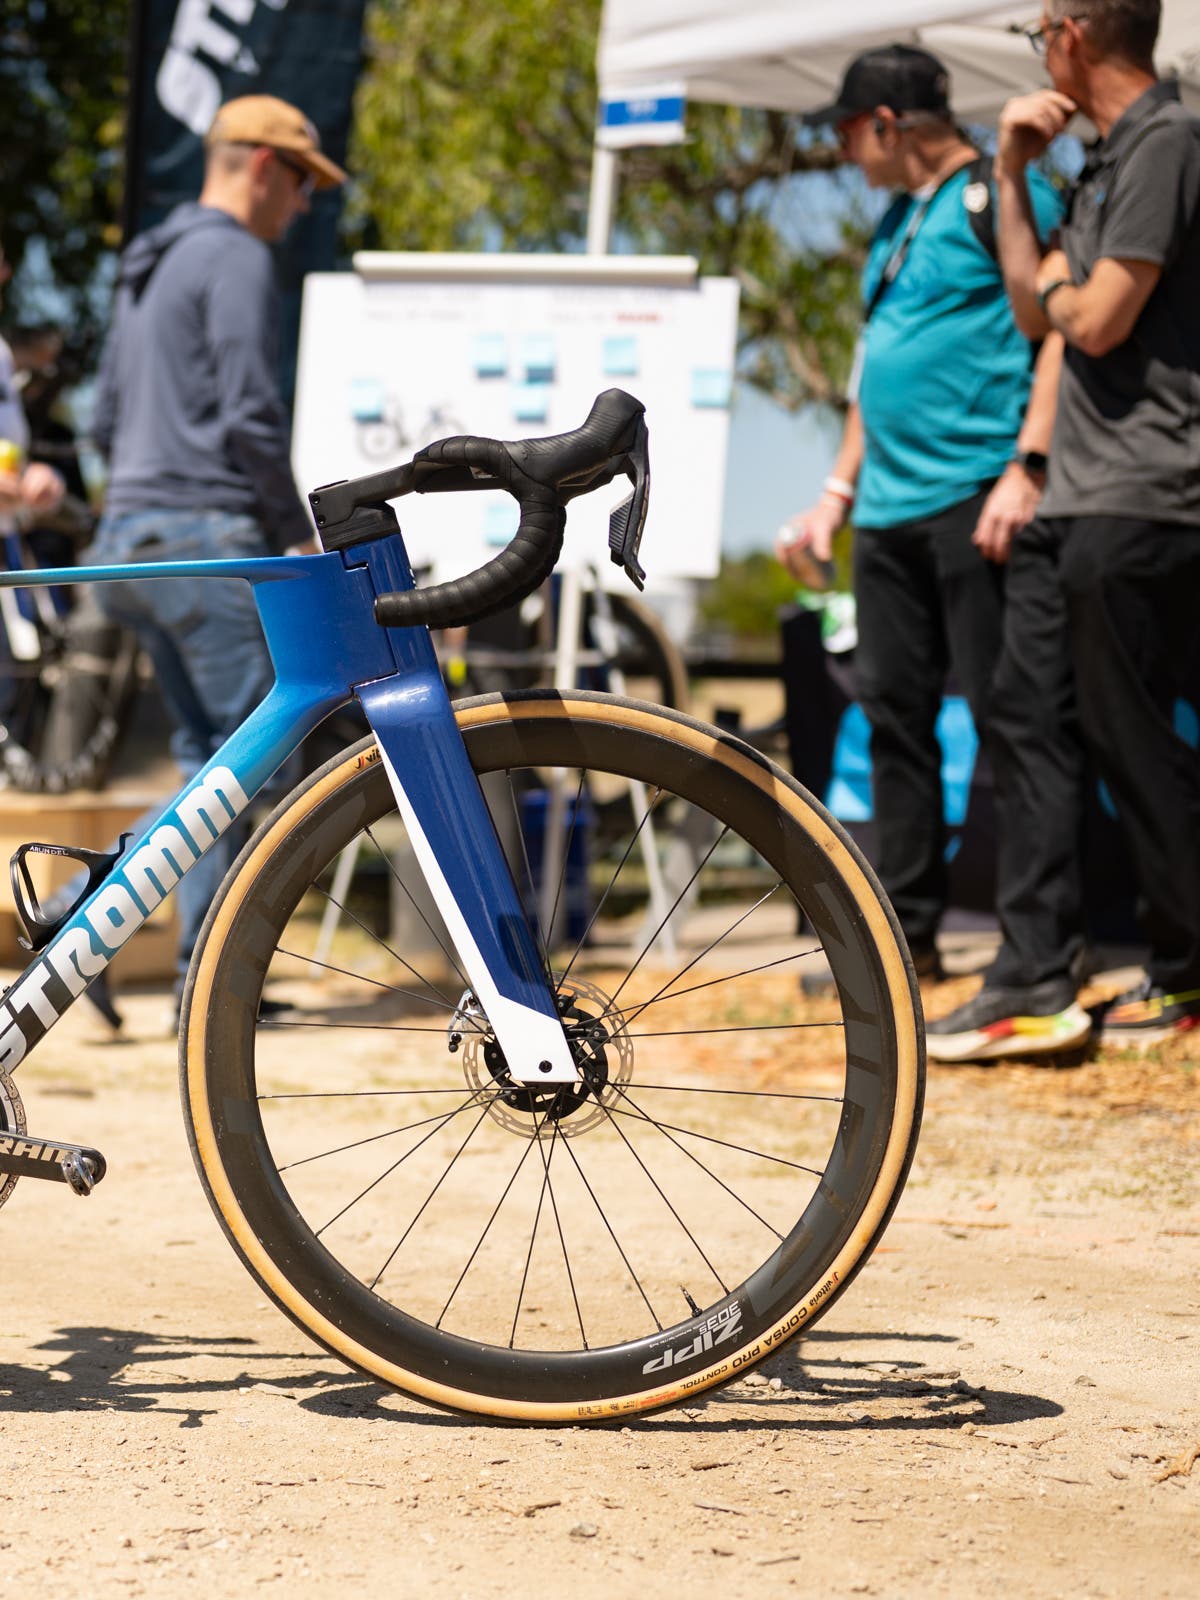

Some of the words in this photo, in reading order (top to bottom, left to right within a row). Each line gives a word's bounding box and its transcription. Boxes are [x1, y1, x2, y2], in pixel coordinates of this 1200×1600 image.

[29, 845, 69, 857] ARUNDEL
[809, 1278, 835, 1307] vittoria
[763, 1307, 808, 1347] CORSA
[642, 1311, 744, 1375] ZIPP
[732, 1346, 761, 1369] PRO
[680, 1365, 728, 1389] CONTROL
